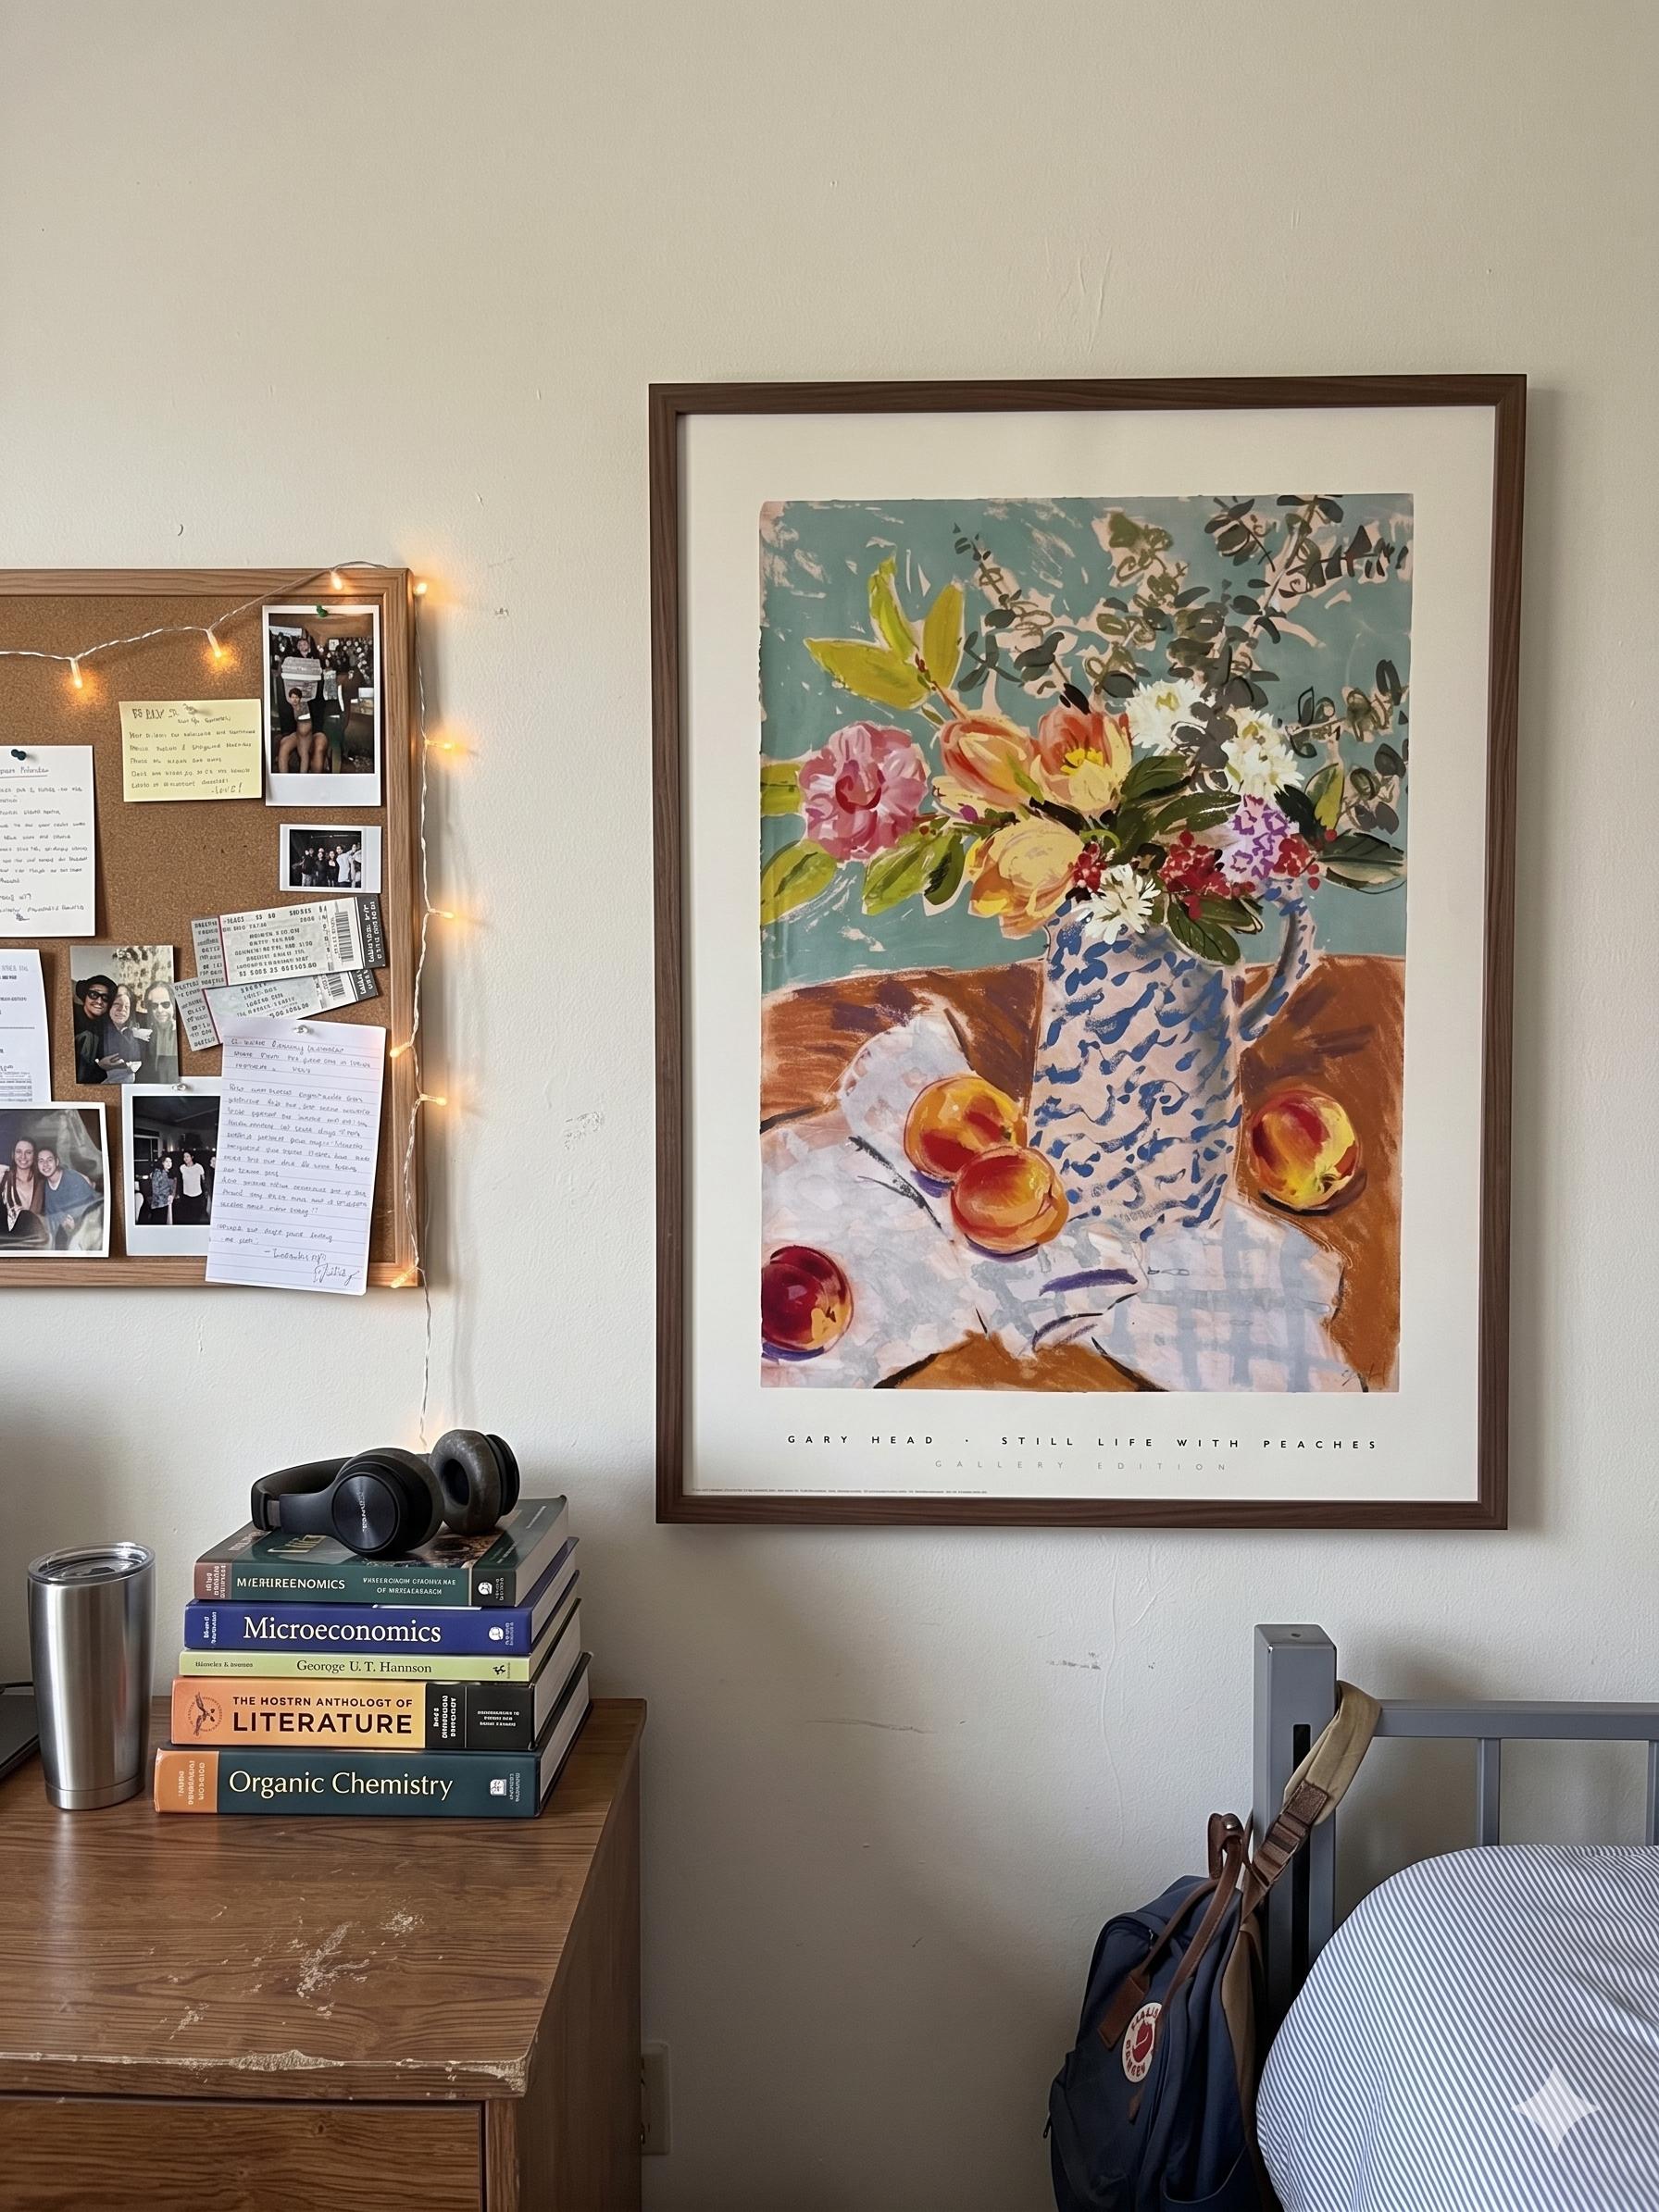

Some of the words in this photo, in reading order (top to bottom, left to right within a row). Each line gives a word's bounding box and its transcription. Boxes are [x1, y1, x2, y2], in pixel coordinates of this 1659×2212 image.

[787, 1435, 848, 1444] GARY
[871, 1435, 932, 1445] HEAD
[1002, 1436, 1073, 1446] STILL
[1098, 1437, 1152, 1447] LIFE
[1176, 1439, 1238, 1448] WITH
[1263, 1440, 1375, 1449] PEACHES
[935, 1460, 1064, 1469] GALLERY
[1097, 1461, 1225, 1471] EDITION
[243, 1617, 441, 1642] Microeconomics
[349, 1660, 362, 1671] U.
[363, 1661, 376, 1672] T.
[380, 1661, 432, 1673] Hannson
[232, 1696, 256, 1706] THE
[260, 1696, 311, 1707] HOSTRN
[316, 1697, 392, 1708] ANTHOLOGT
[395, 1698, 413, 1709] OF
[233, 1711, 412, 1734] LITERATURE
[230, 1771, 324, 1798] Organic
[332, 1772, 453, 1800] Chemistry
